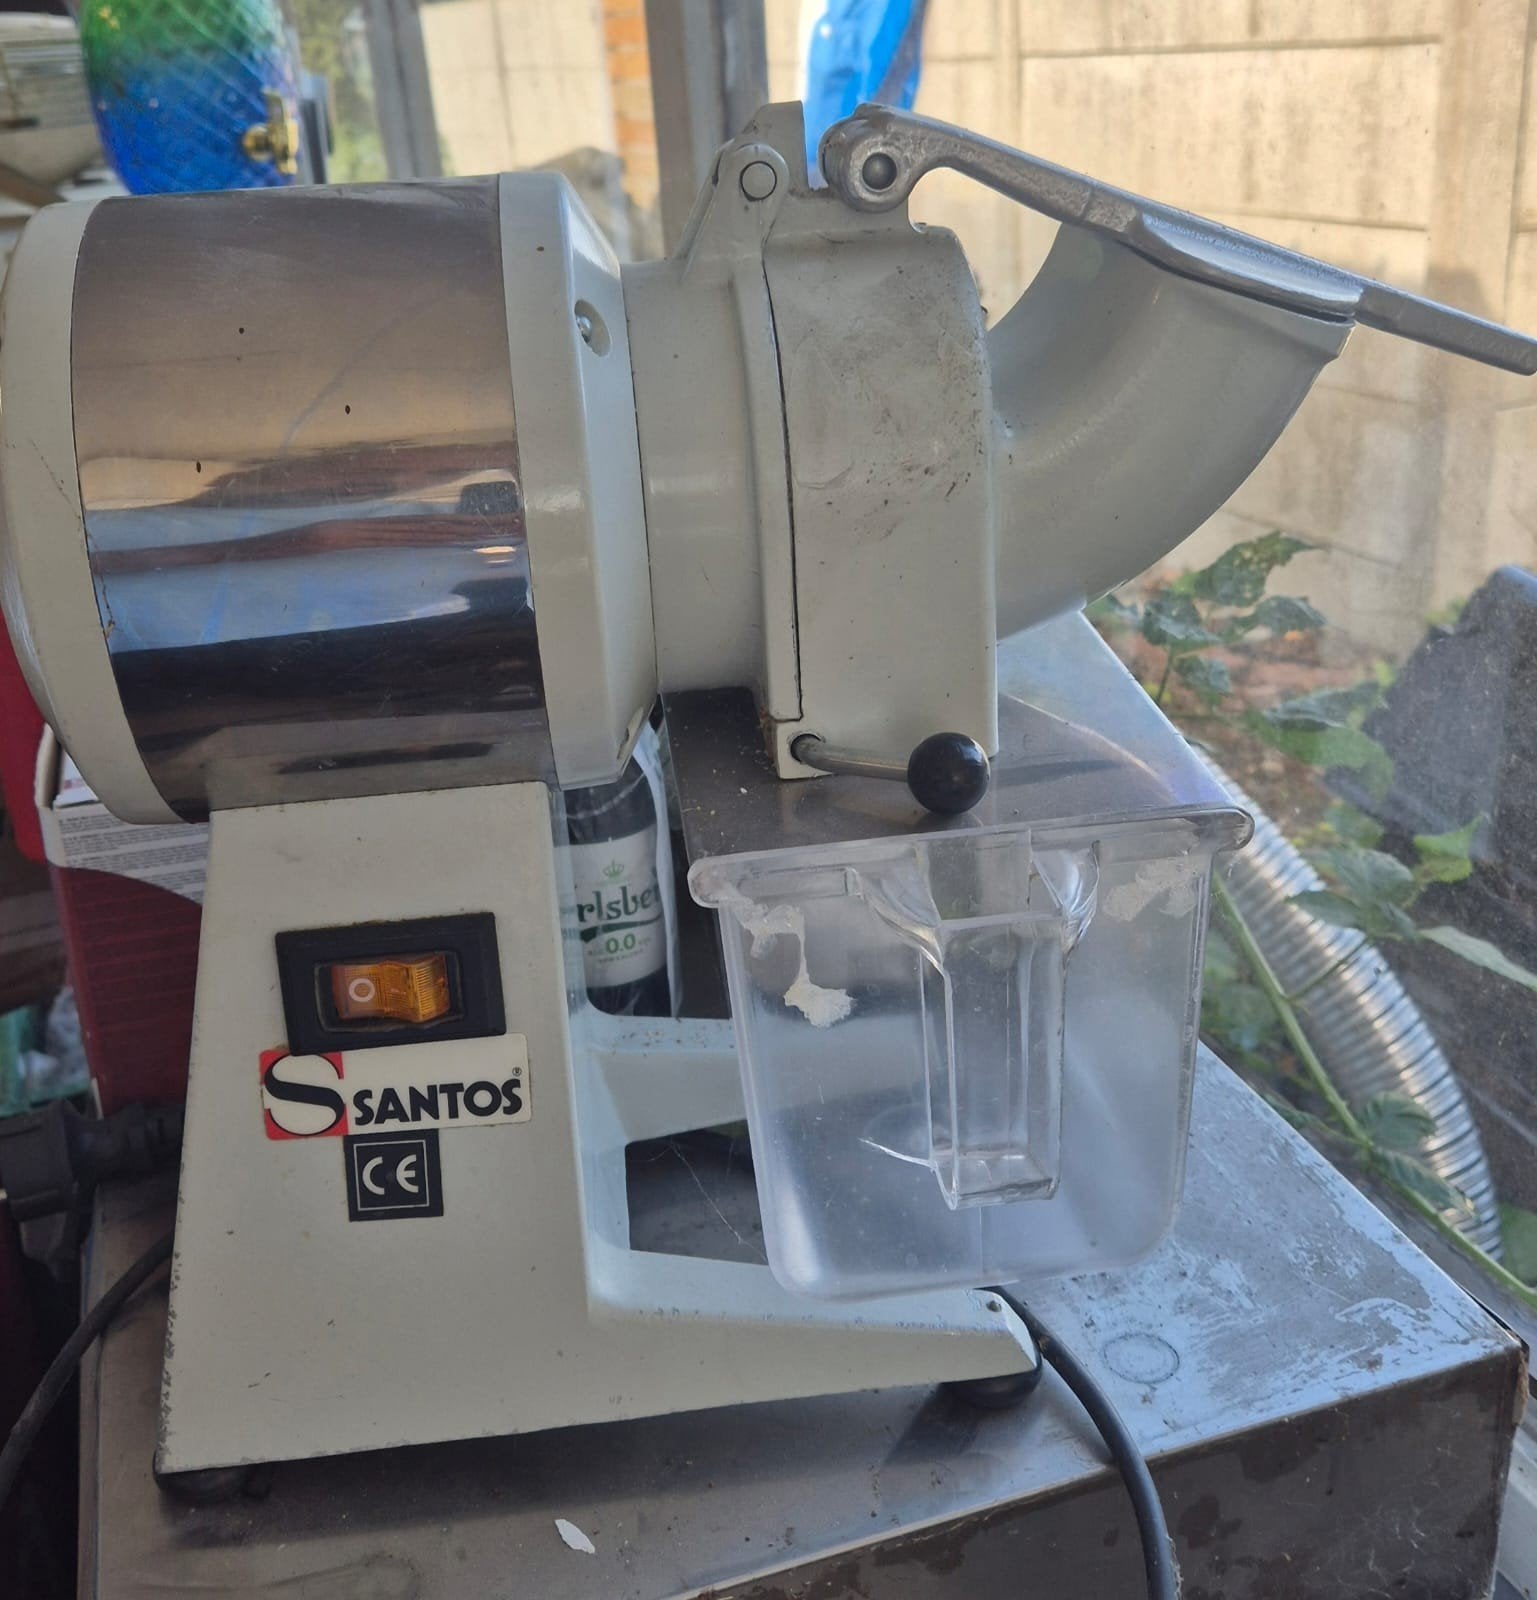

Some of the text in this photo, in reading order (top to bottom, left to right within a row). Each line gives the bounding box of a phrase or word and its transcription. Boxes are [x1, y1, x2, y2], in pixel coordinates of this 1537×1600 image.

[605, 933, 636, 954] 0.0
[352, 1078, 523, 1126] SANTOS
[361, 1153, 419, 1196] CE
